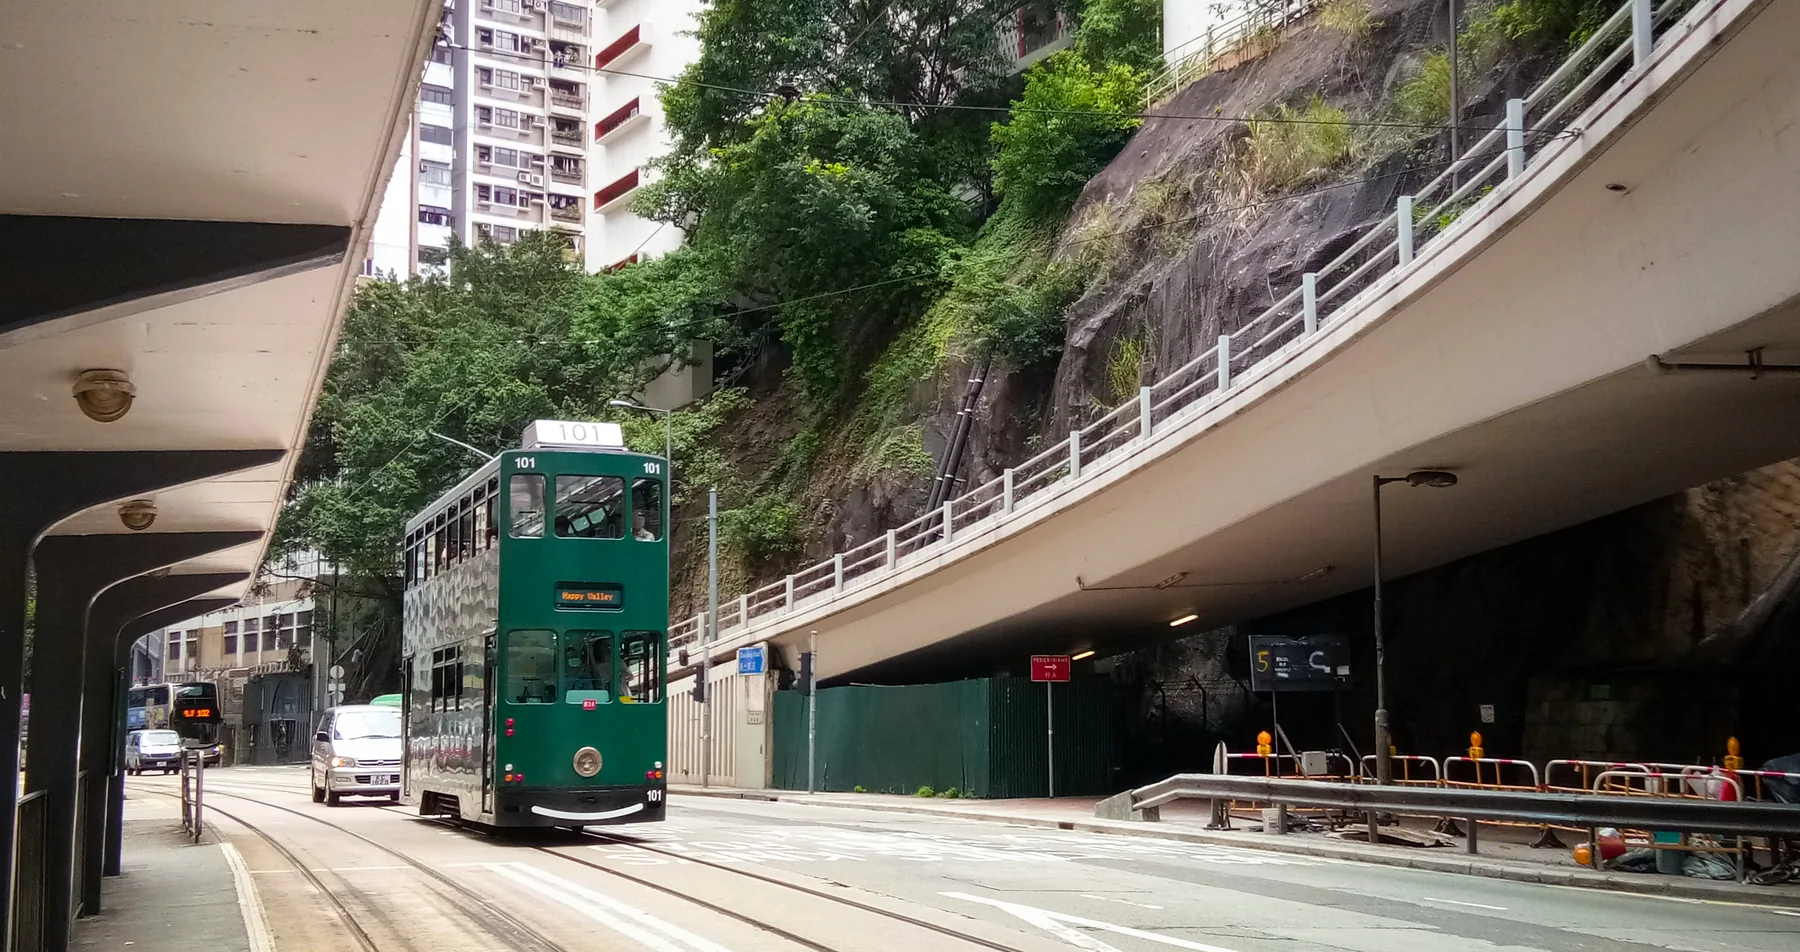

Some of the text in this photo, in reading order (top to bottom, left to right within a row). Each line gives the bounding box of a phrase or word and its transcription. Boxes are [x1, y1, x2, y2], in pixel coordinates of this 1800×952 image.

[559, 423, 600, 442] 101
[514, 457, 535, 469] 101
[643, 462, 660, 475] 101
[1256, 650, 1269, 672] 5
[646, 789, 662, 801] 101
